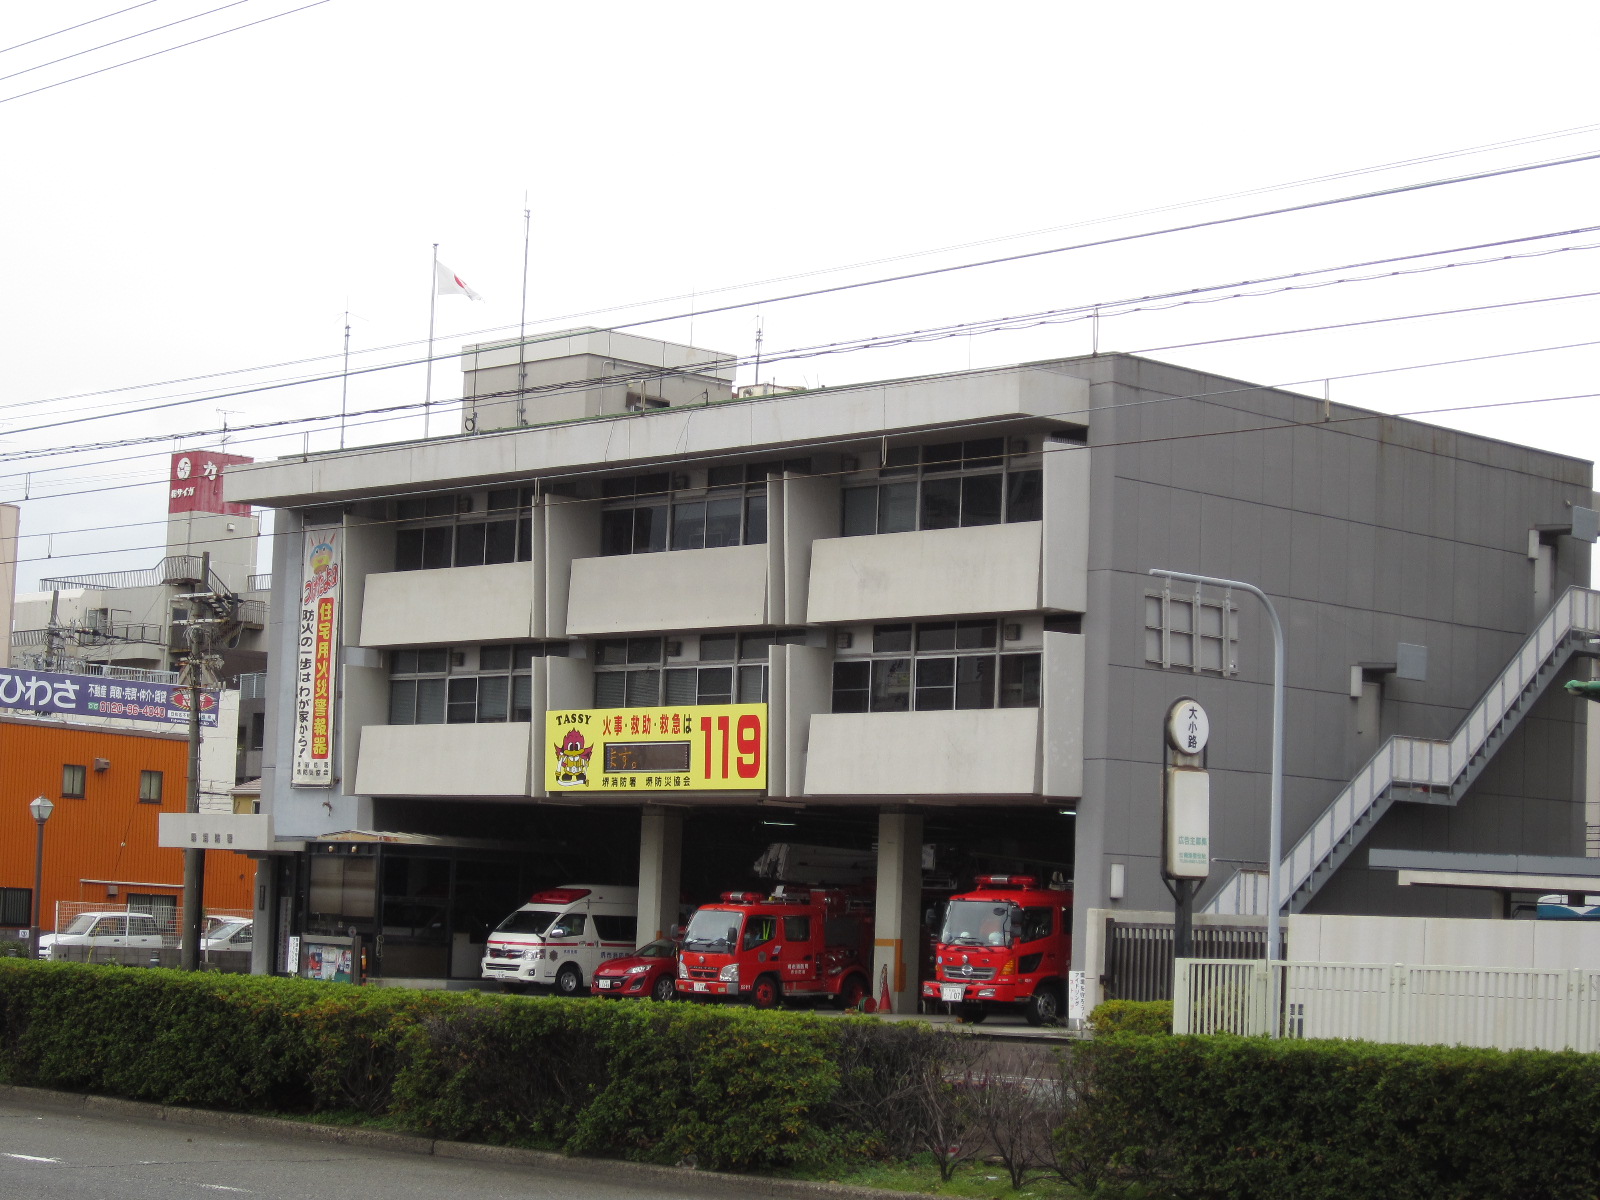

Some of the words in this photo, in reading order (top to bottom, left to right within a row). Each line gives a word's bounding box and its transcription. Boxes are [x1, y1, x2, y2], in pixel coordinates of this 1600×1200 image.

[313, 602, 332, 755] 住宅用火災警報器
[0, 674, 80, 708] ひわさ
[88, 683, 107, 698] 不動産
[100, 701, 165, 718] 0120-96-4040
[556, 713, 592, 726] TASSY
[602, 713, 692, 736] 火事・救助・救急は
[1187, 706, 1198, 749] 大小路
[700, 714, 761, 779] 119
[602, 777, 637, 788] 堺消防署
[645, 776, 691, 788] 堺防災協会
